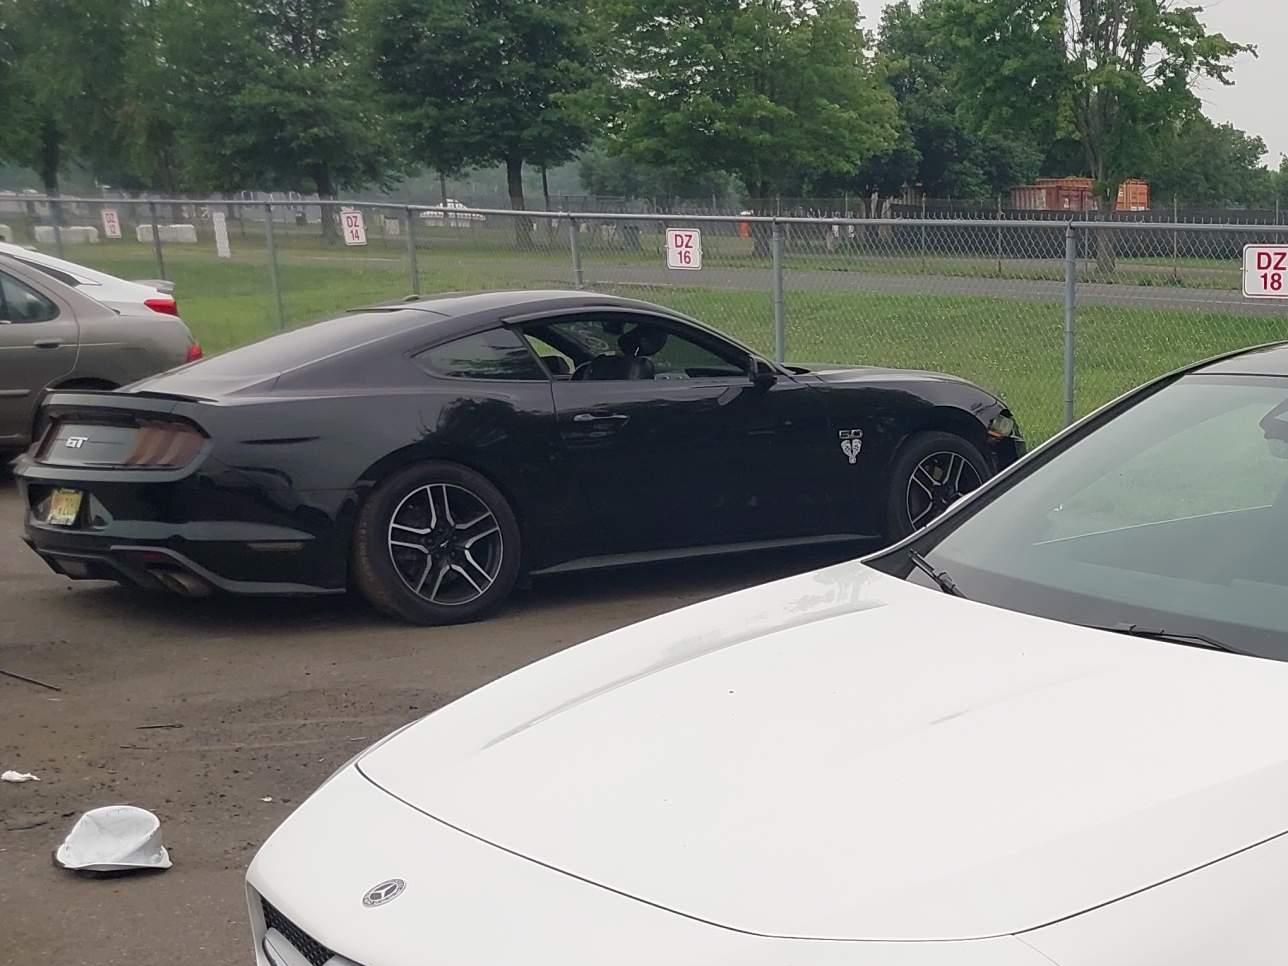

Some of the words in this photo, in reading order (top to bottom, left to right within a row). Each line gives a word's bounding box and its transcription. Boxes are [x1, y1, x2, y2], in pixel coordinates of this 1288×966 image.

[346, 215, 360, 228] DZ
[350, 229, 360, 241] 14
[674, 233, 693, 249] DZ
[677, 250, 692, 265] 16
[1257, 251, 1288, 271] DZ
[1260, 272, 1283, 291] 18
[65, 436, 89, 449] GT
